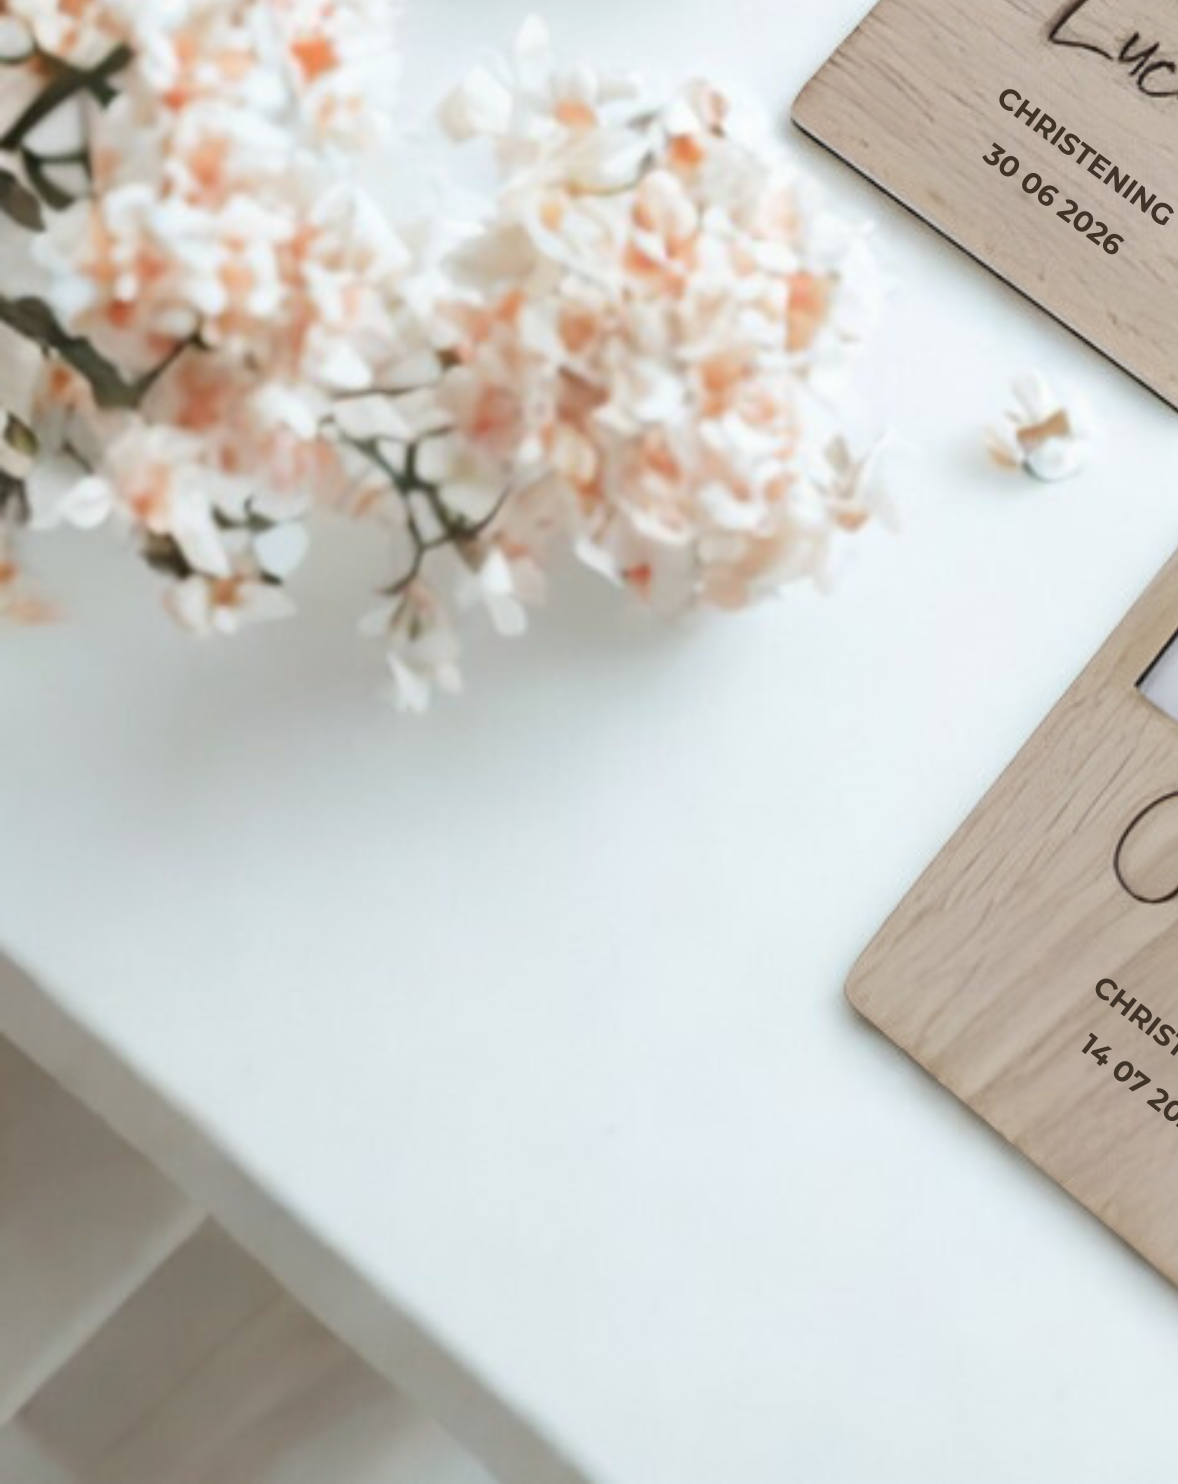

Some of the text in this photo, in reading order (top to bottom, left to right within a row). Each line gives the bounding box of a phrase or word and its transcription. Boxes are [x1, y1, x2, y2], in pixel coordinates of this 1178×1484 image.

[982, 142, 1125, 255] 30 06 2026
[998, 88, 1175, 226] CHRISTENING
[1080, 1032, 1113, 1067] 14
[1113, 1060, 1152, 1093] 07
